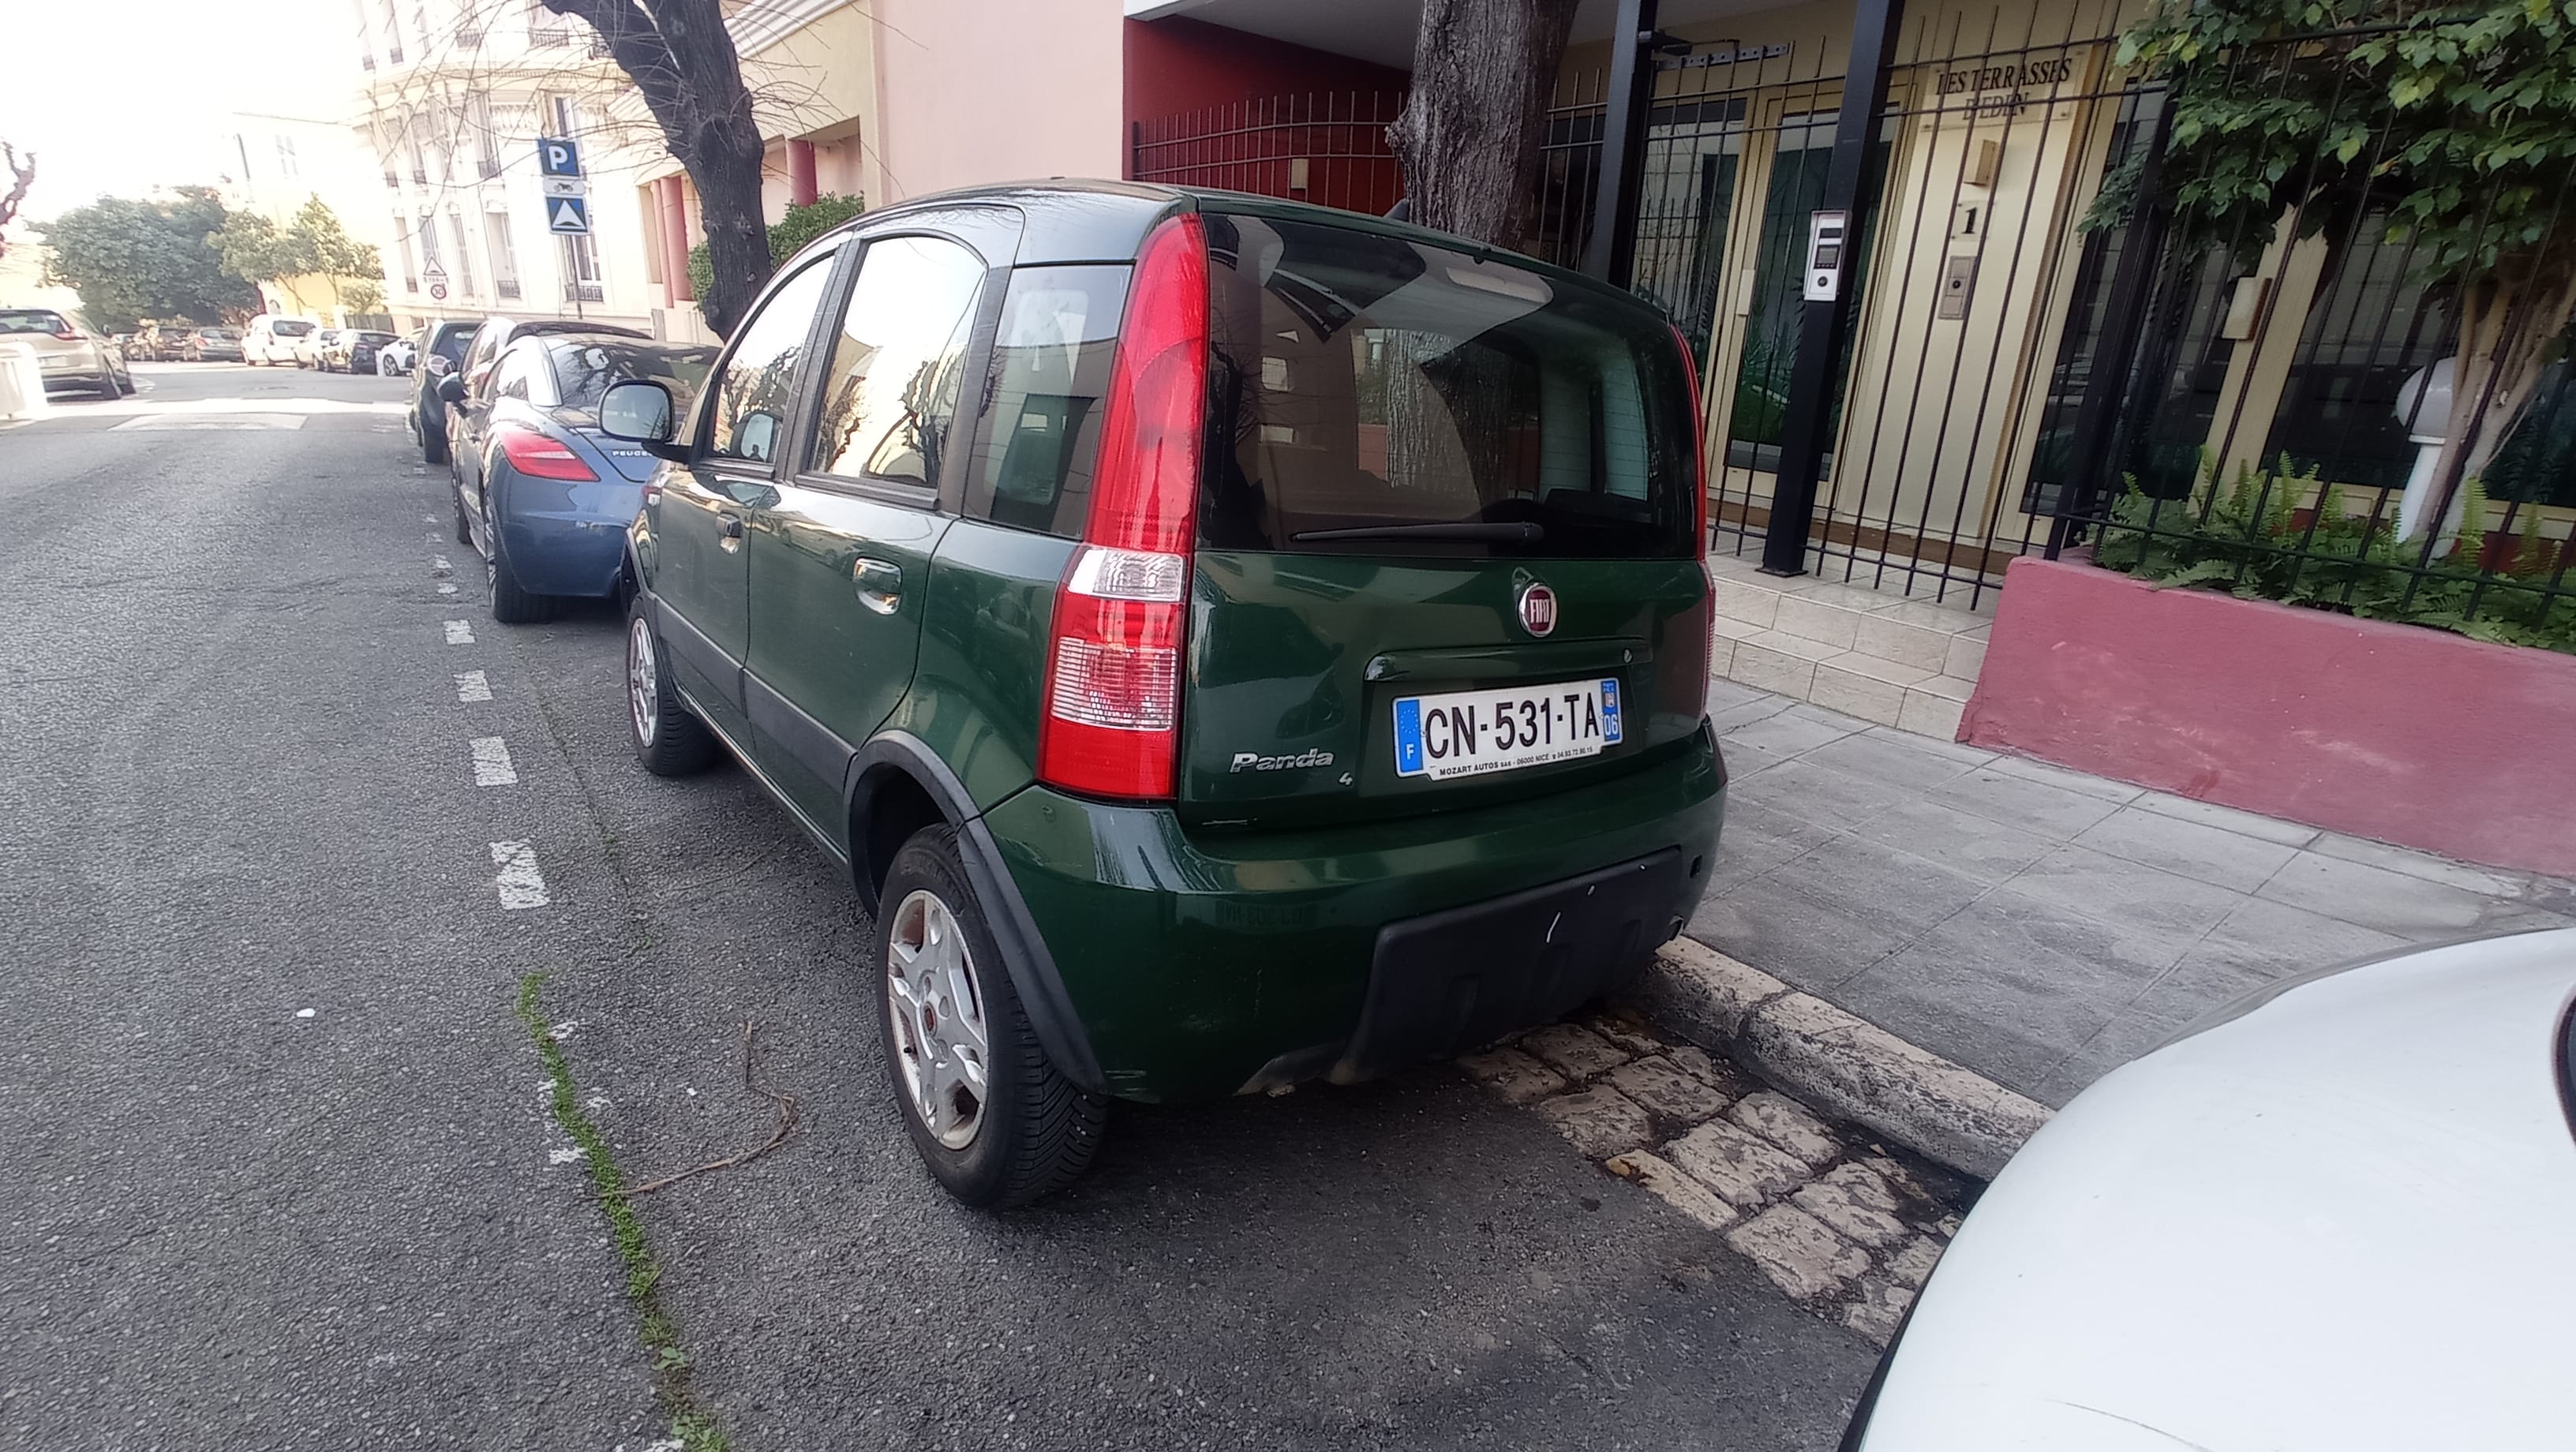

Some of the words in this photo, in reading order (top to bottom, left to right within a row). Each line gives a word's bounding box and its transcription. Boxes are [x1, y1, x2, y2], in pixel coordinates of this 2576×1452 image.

[548, 145, 568, 170] P
[1960, 207, 1977, 234] 1
[1530, 598, 1550, 623] FIAT
[1425, 692, 1600, 759] CN-531-TA
[1604, 713, 1619, 736] 06
[1230, 748, 1335, 773] Panda
[1406, 743, 1414, 760] F
[1440, 765, 1472, 776] MOZART
[1473, 762, 1499, 771] AUTOS
[1535, 753, 1549, 762] NICE
[1339, 772, 1353, 785] 4
